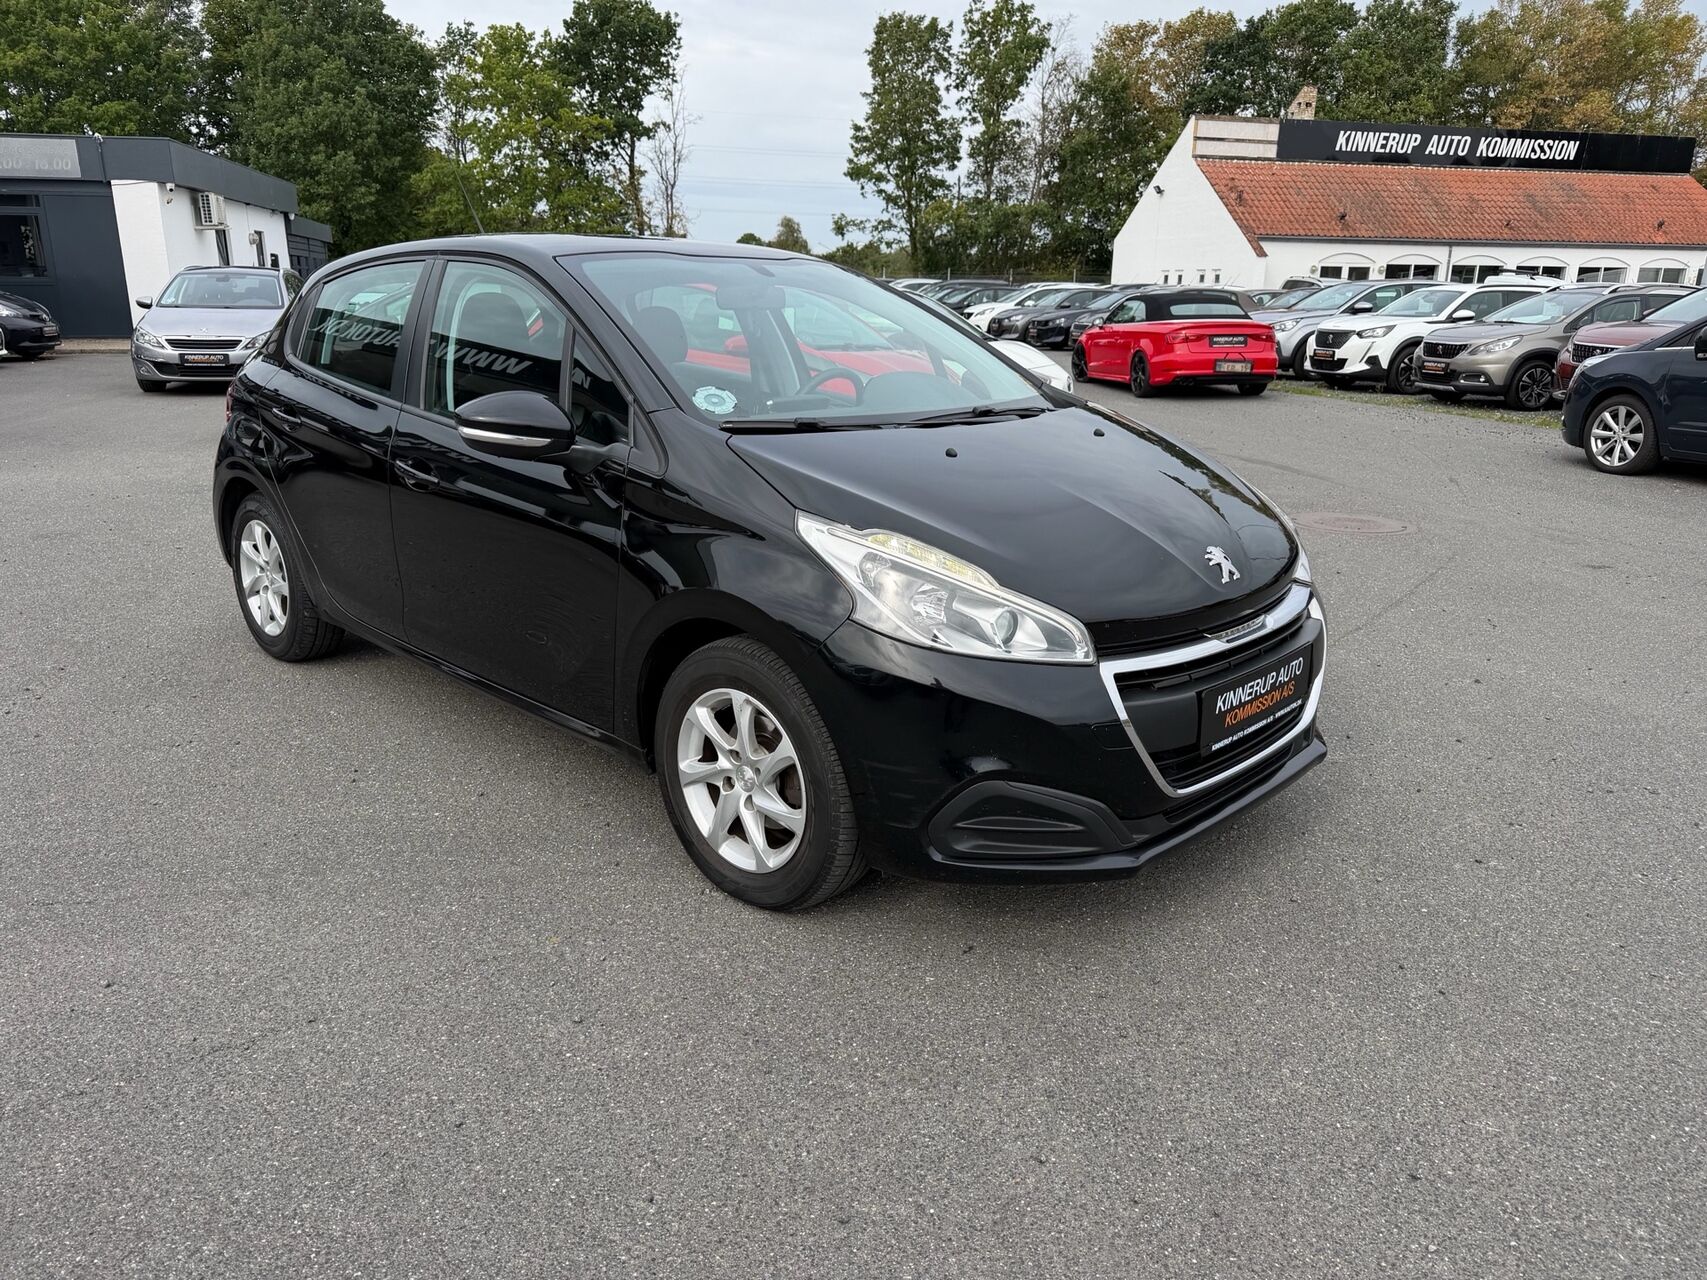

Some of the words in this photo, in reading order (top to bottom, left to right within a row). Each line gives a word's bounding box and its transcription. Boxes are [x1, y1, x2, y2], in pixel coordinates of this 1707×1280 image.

[1335, 130, 1421, 154] KINNERUP
[1425, 135, 1471, 156] AUTO
[1476, 136, 1580, 161] KOMMISSION
[1215, 671, 1276, 714] KINNERUP
[1276, 657, 1304, 687] AUTO
[1225, 688, 1282, 728] KOMMISSION
[1281, 680, 1295, 700] A/S
[1211, 736, 1233, 751] KINNERUP
[1232, 730, 1244, 742] AUTO
